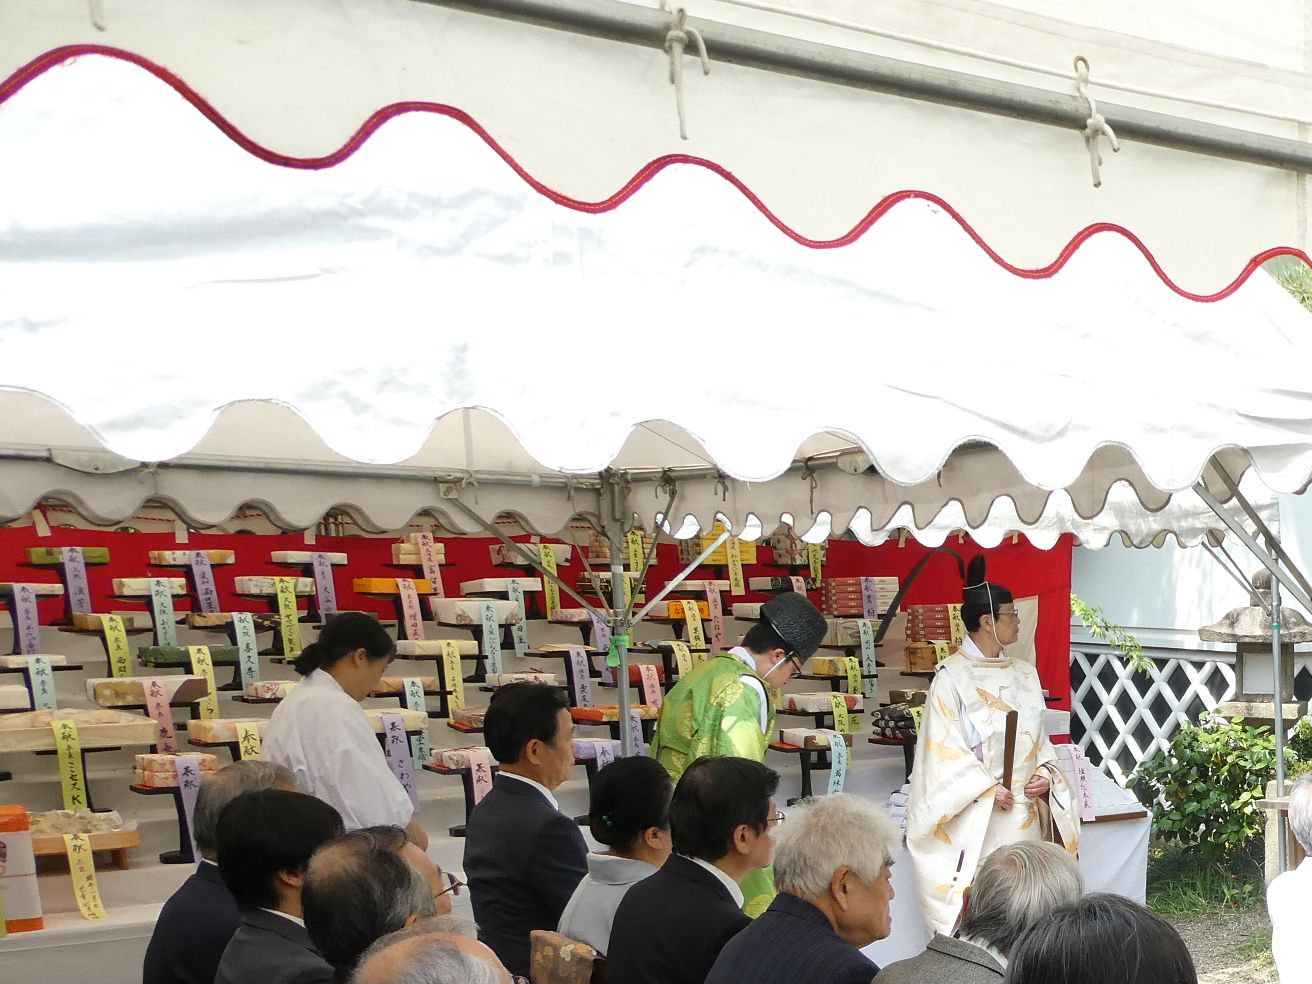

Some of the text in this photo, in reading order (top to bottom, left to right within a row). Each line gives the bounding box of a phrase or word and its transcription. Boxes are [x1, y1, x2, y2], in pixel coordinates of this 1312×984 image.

[108, 616, 122, 632] 奉献
[35, 658, 48, 676] 奉献
[149, 680, 164, 698] 奉献
[410, 680, 422, 698] 奉献
[61, 722, 76, 742] 奉献
[390, 721, 404, 744] 奉献
[241, 728, 260, 757] 奉献
[182, 765, 198, 790] 奉献
[476, 762, 488, 784] 奉献
